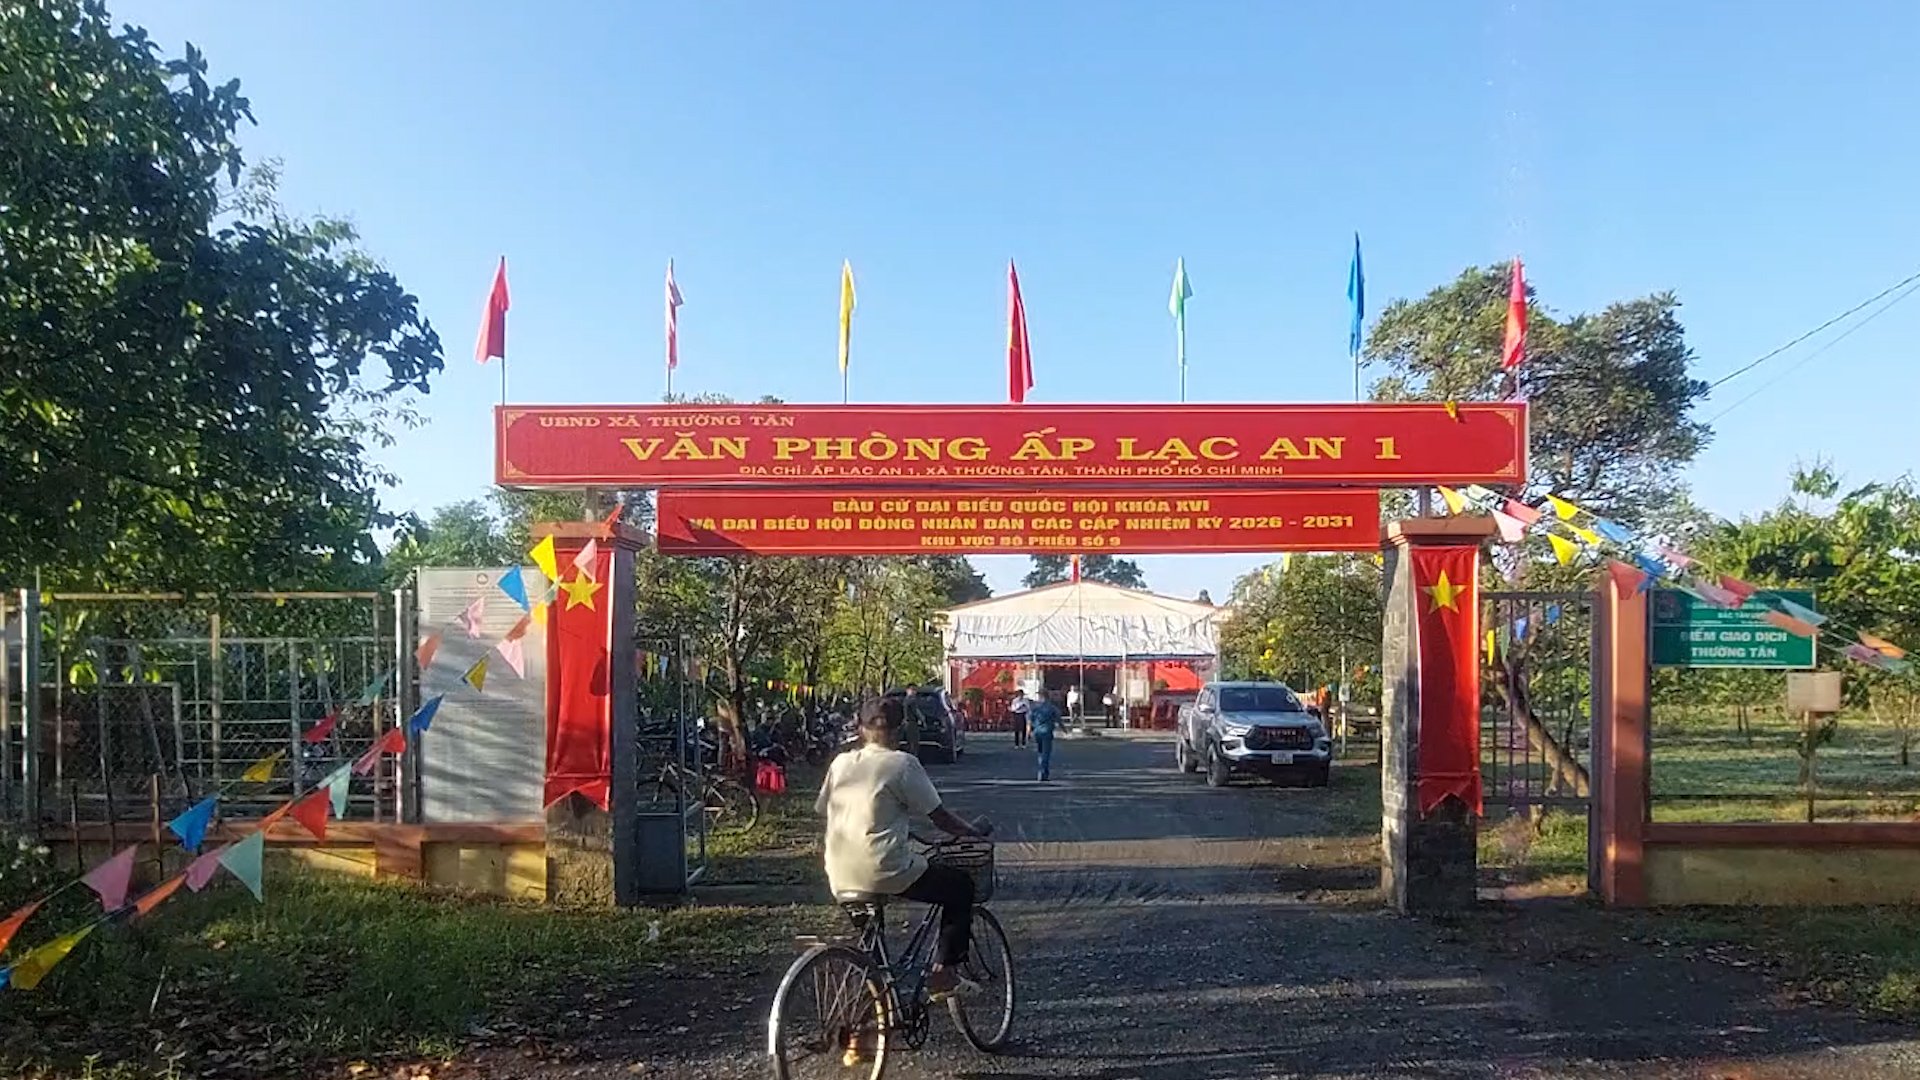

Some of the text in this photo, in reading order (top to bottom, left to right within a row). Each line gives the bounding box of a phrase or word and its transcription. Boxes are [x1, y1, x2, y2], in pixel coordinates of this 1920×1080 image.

[538, 413, 795, 428] UBND XÃ THƯỜNG TÂN
[620, 426, 1401, 465] VĂN PHÒNG ẤP LẠC AN 1
[739, 466, 767, 477] ĐỊA
[811, 463, 834, 476] ẤP
[840, 465, 874, 477] LẠC
[878, 466, 902, 476] AN
[926, 464, 948, 476] XÃ
[953, 463, 1025, 476] THƯỜNG
[1075, 464, 1132, 476] THÀNH
[1137, 462, 1173, 476] PHỐ
[1207, 465, 1236, 476] CHÍ
[1240, 466, 1285, 476] MINH
[915, 500, 950, 514] ĐẠI
[1009, 498, 1066, 514] QUỐC
[1072, 499, 1108, 514] HỘI
[1115, 499, 1171, 513] KHÓA
[1176, 500, 1210, 512] XVI
[722, 518, 757, 531] ĐẠI
[816, 517, 852, 531] HỘI
[921, 516, 977, 530] NHÂN
[984, 516, 1025, 530] DÂN
[1031, 516, 1073, 530] CÁC
[1079, 515, 1120, 530] CẤP
[1125, 517, 1191, 531] NHIỆM
[1229, 516, 1282, 529] 2026
[1303, 515, 1353, 528] 2031
[920, 536, 956, 547] KHU
[1028, 535, 1077, 547] PHIẾU
[1081, 535, 1105, 547] SỐ
[1109, 536, 1121, 547] 9
[1719, 631, 1752, 642] GIAO
[1749, 645, 1778, 658] TÂN
